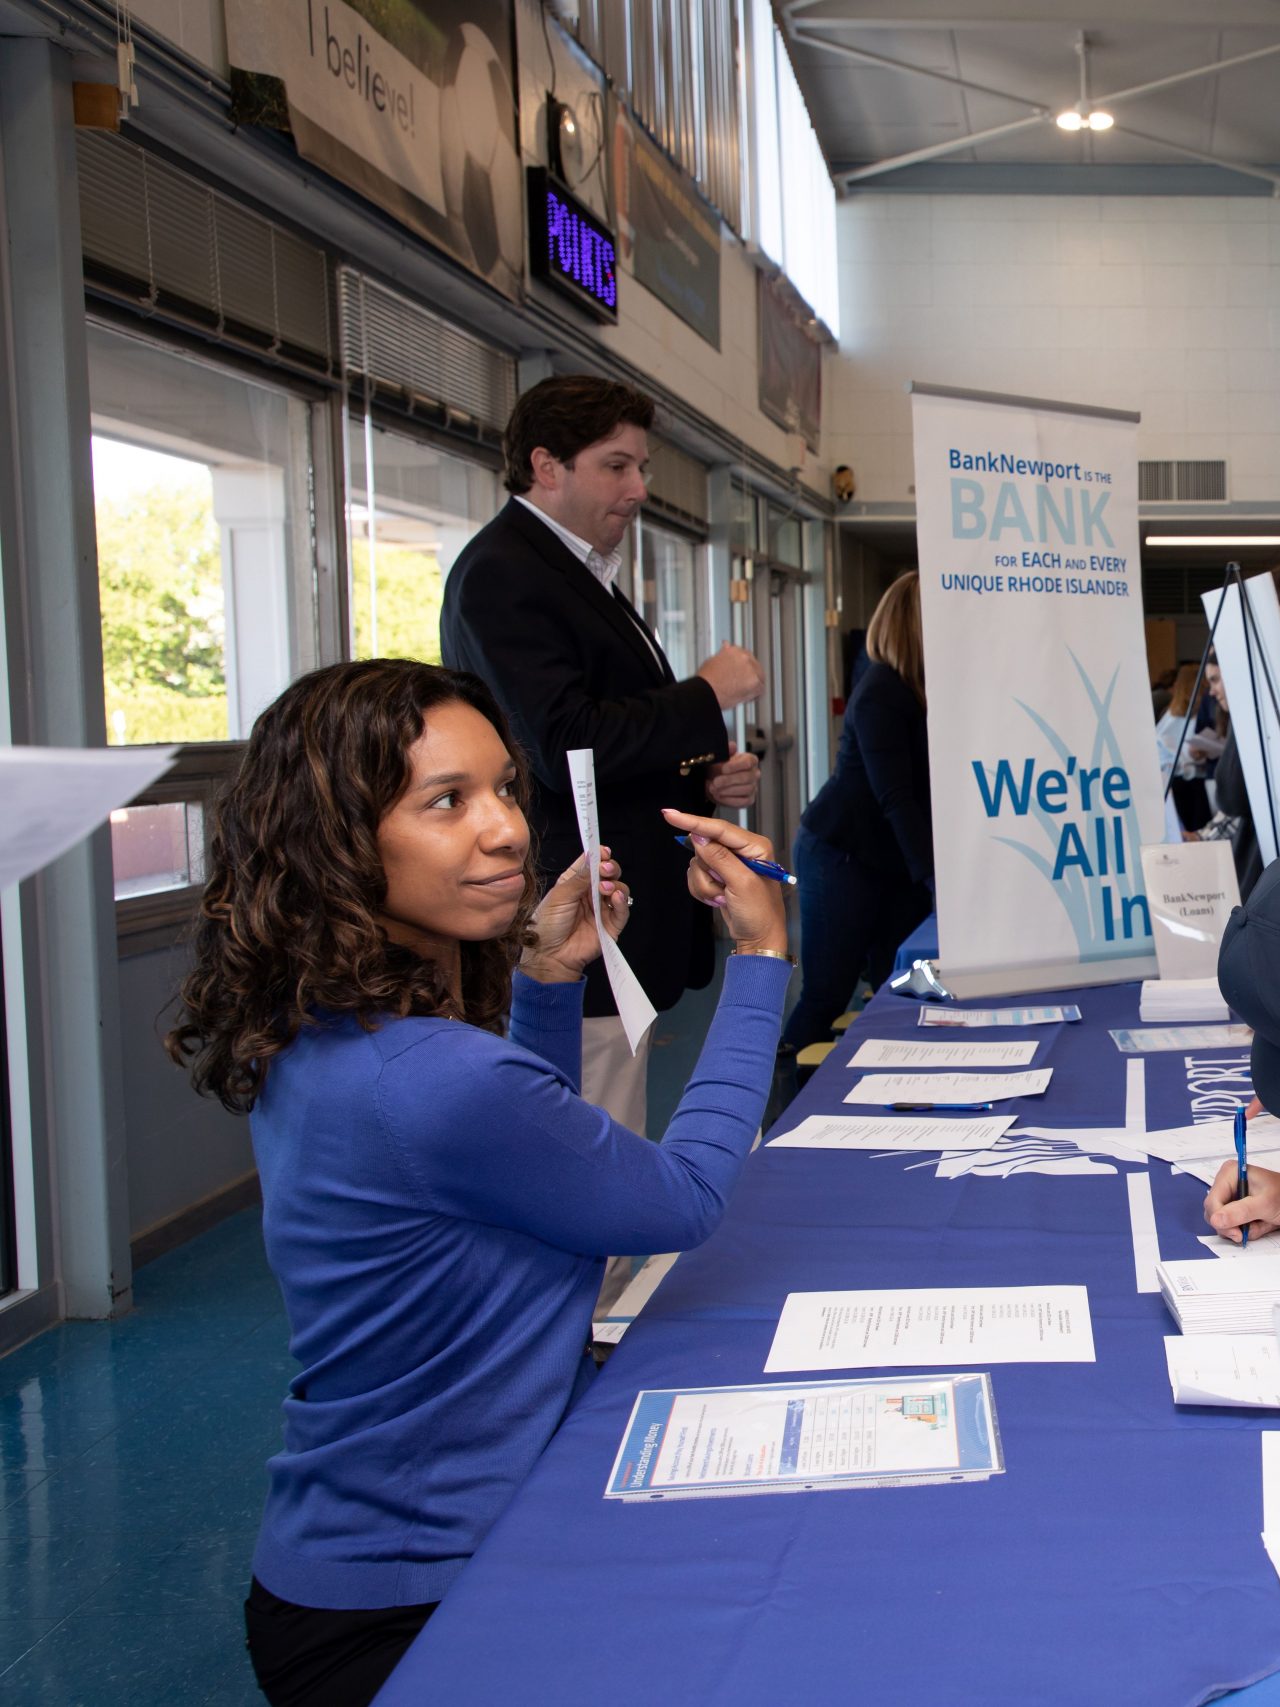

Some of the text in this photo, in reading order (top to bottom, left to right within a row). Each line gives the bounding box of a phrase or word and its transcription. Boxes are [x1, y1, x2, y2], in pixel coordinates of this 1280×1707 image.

[307, 0, 416, 140] I believe!
[547, 191, 615, 307] POINTS
[949, 449, 1112, 484] BankNewport IS THE
[950, 477, 1116, 549] BANK
[941, 574, 1130, 597] UNIQUE RHODE ISLANDER
[995, 552, 1127, 573] FOR EACH AND EVERY
[971, 756, 1131, 818] We're
[1052, 816, 1126, 880] All
[1102, 886, 1153, 941] In
[1163, 892, 1226, 905] BankNewport
[1179, 906, 1215, 917] (Loans)
[630, 1423, 664, 1488] Understanding Money
